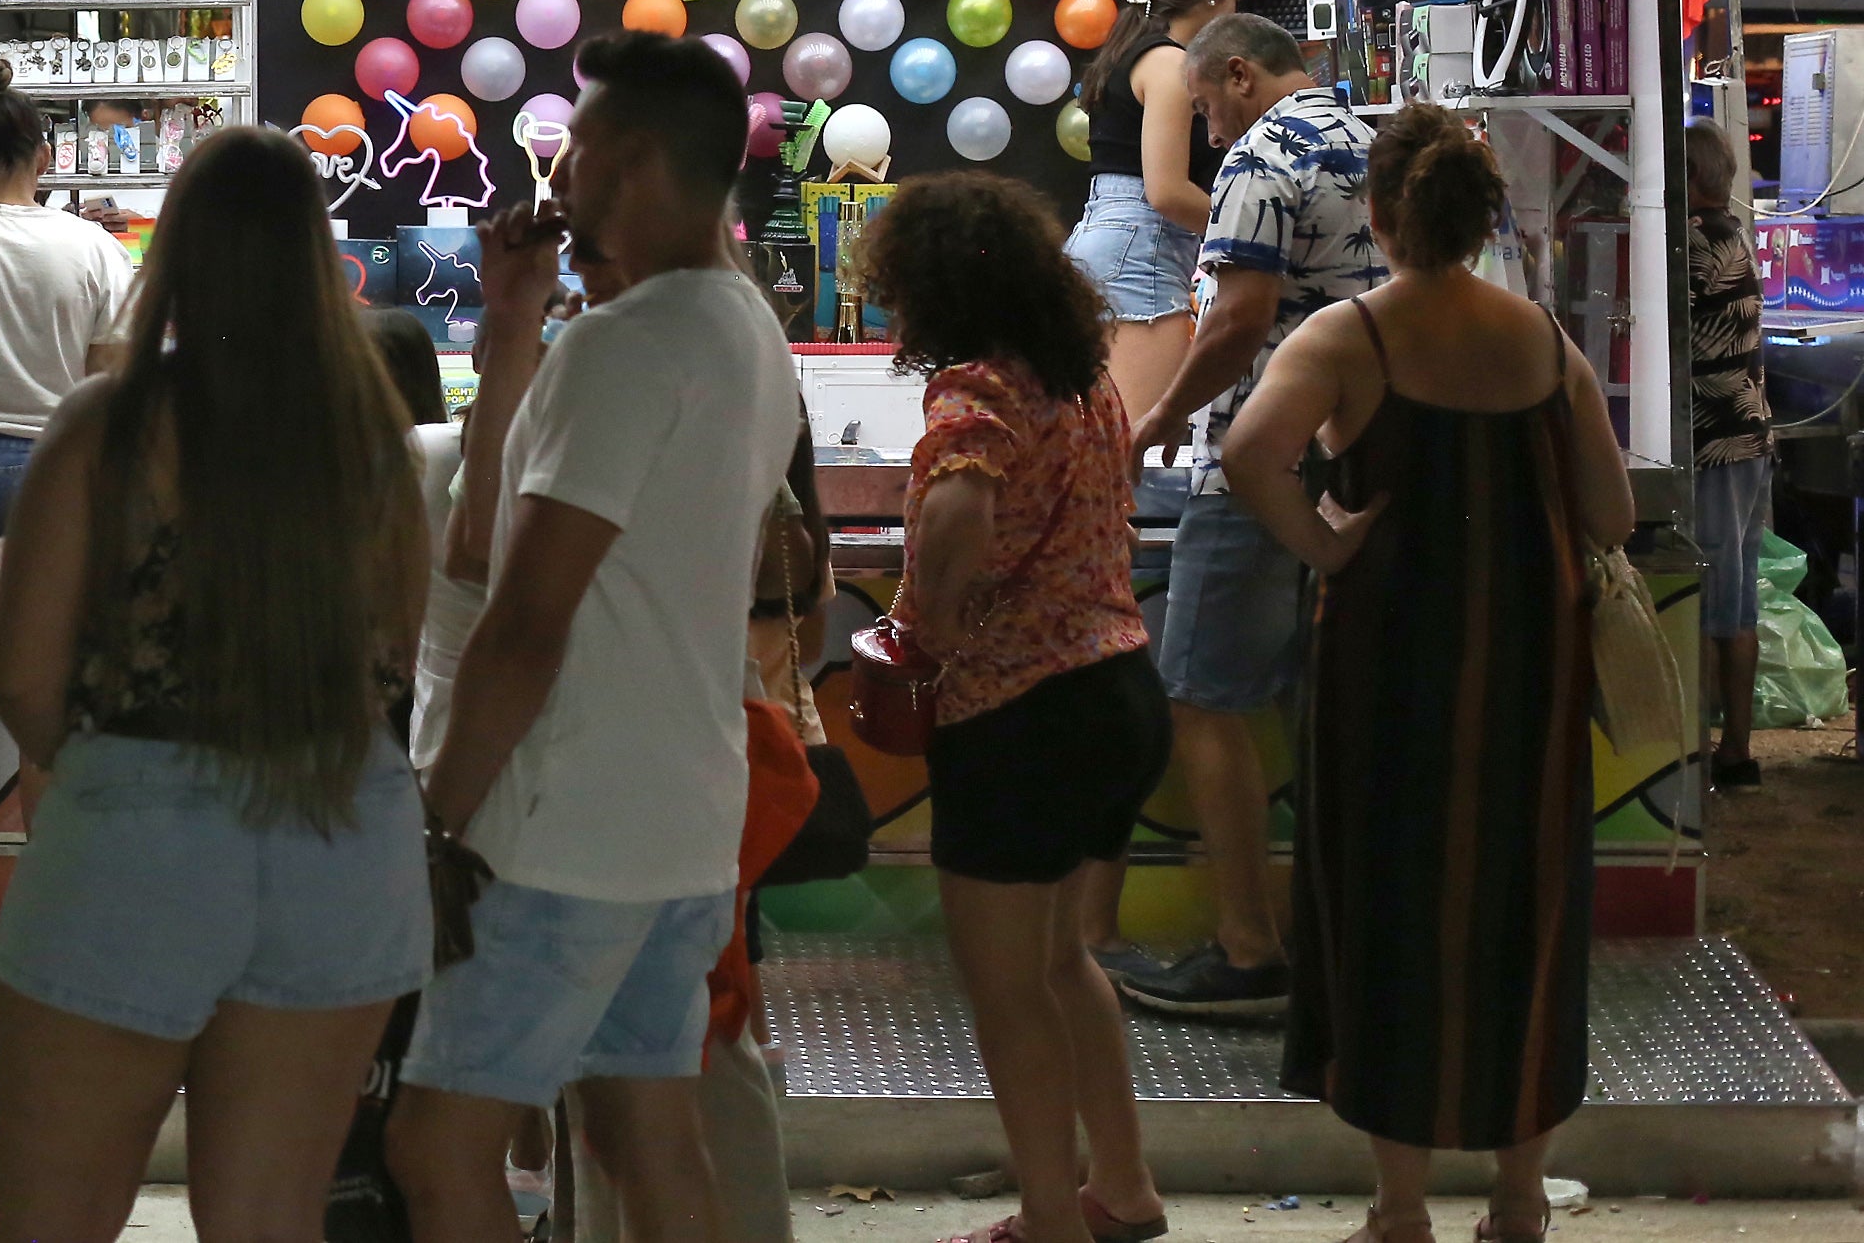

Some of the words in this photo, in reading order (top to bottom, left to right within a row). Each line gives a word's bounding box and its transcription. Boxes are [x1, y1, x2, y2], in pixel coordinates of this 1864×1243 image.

[1584, 43, 1592, 57] LED
[1585, 57, 1593, 71] LUZ
[1585, 72, 1593, 88] ARO
[309, 151, 355, 184] ove
[445, 388, 474, 396] LIGHT
[445, 396, 465, 404] POP
